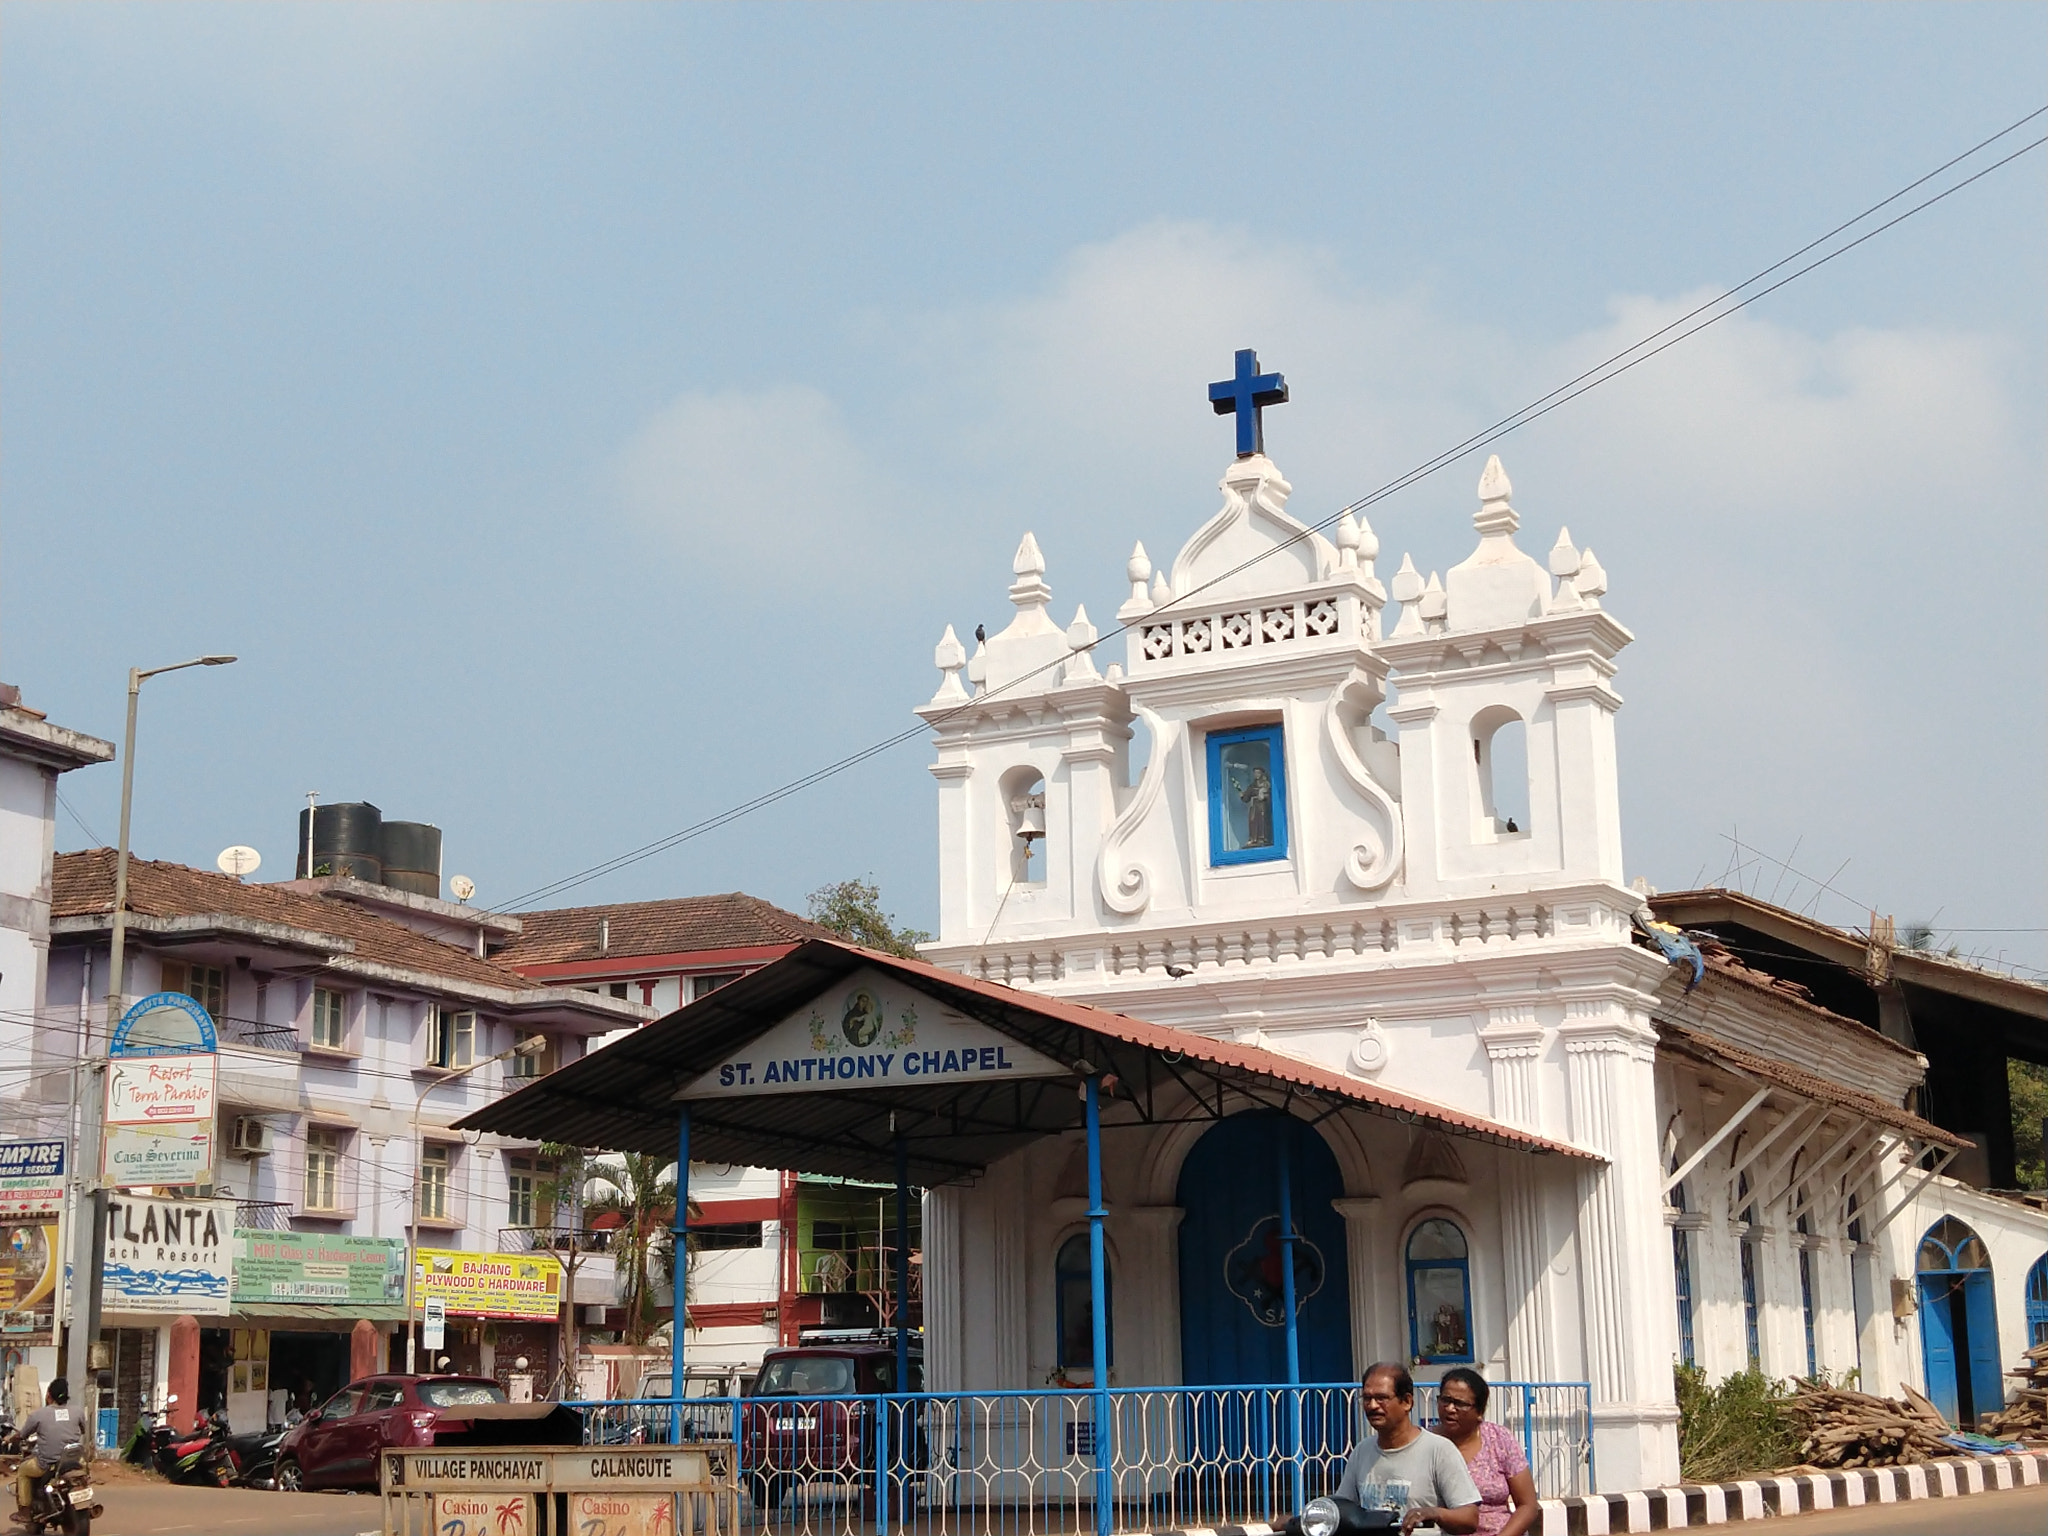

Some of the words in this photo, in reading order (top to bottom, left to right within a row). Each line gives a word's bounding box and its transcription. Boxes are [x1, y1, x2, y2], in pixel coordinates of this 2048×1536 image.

[148, 1062, 192, 1083] Resort
[720, 1063, 754, 1086] ST.
[763, 1054, 895, 1084] ANTHONY
[903, 1047, 1012, 1075] CHAPEL
[129, 1086, 161, 1103] Terra
[164, 1084, 209, 1102] Paraiso
[114, 1150, 142, 1164] Casa
[146, 1149, 199, 1163] Severina
[0, 1166, 23, 1176] EACH
[25, 1165, 56, 1175] RESORT
[2, 1180, 29, 1188] EMPIRE
[31, 1179, 51, 1187] CAFE
[14, 1189, 59, 1199] RESTAURANT
[107, 1202, 219, 1247] TLANTA
[109, 1246, 139, 1259] ach
[157, 1248, 217, 1263] Resort
[254, 1243, 276, 1258] MRF
[280, 1245, 303, 1260] Glass
[307, 1249, 314, 1260] &
[318, 1247, 357, 1262] Hardware
[361, 1249, 386, 1263] Centre
[463, 1262, 511, 1276] BAJRANG
[425, 1274, 475, 1288] PLYWOOD
[478, 1277, 485, 1288] &
[488, 1279, 545, 1292] HARDWARE
[415, 1460, 466, 1479] VILLAGE
[470, 1460, 543, 1479] PANCHAYAT
[591, 1458, 672, 1477] CALANGUTE
[442, 1499, 488, 1515] Casino
[582, 1497, 630, 1515] Casino
